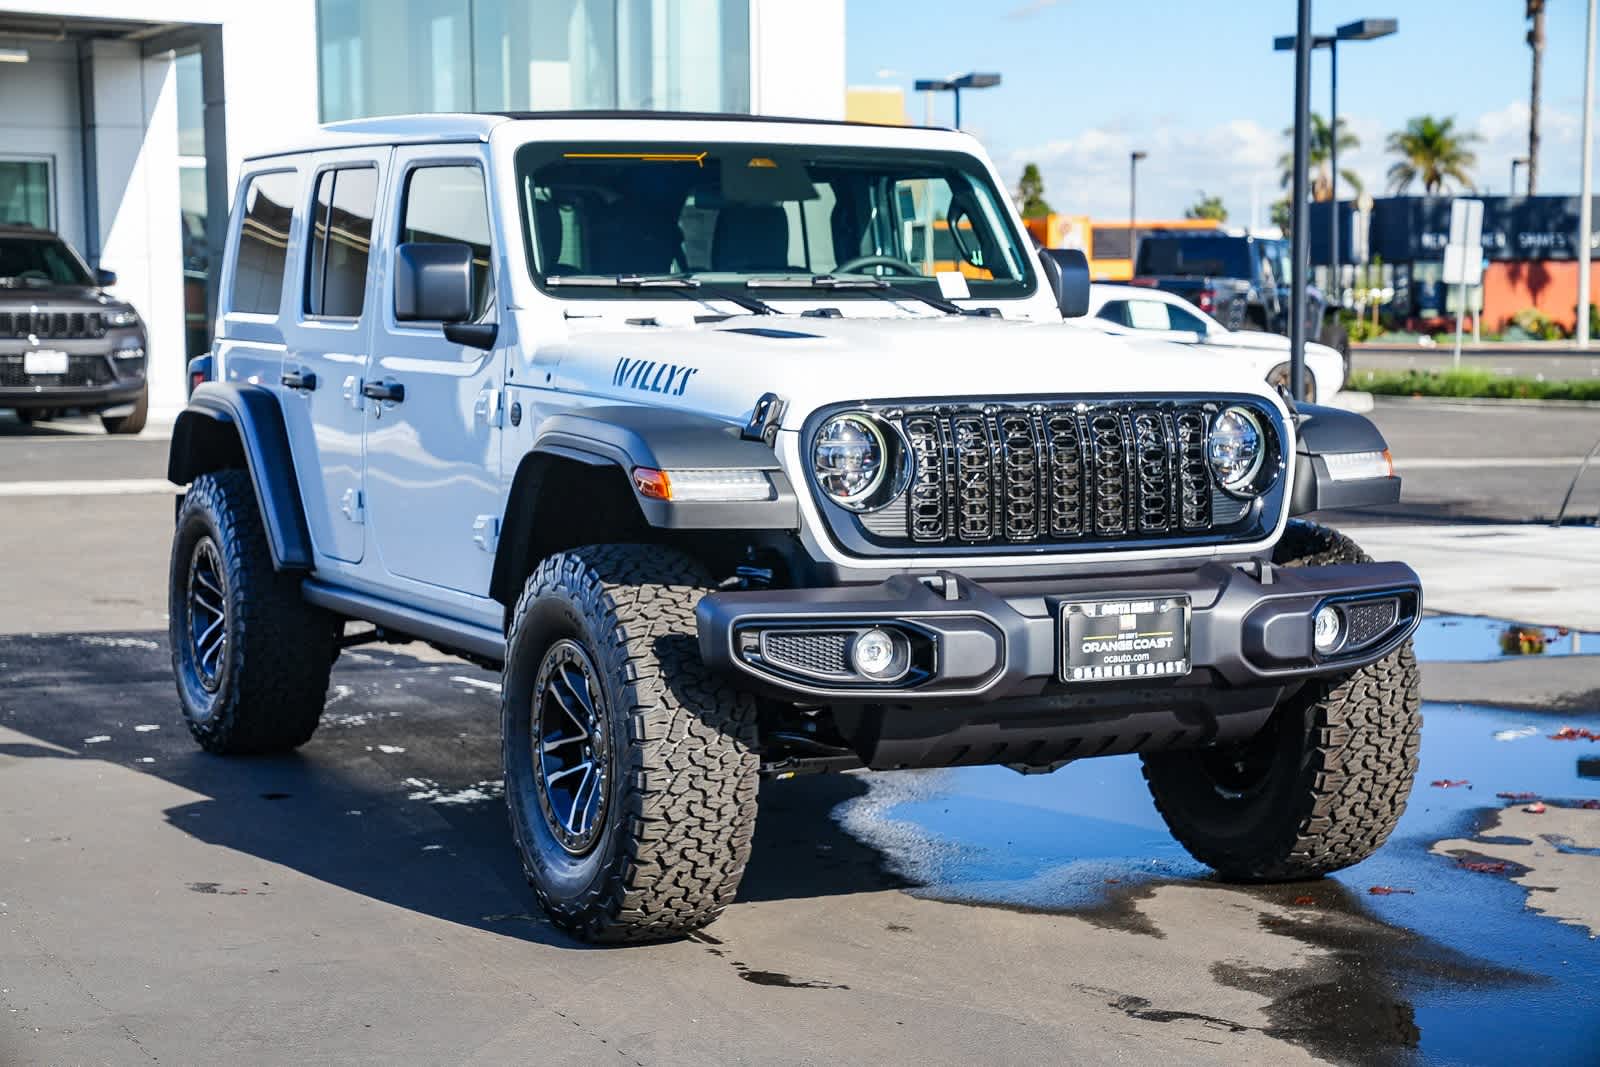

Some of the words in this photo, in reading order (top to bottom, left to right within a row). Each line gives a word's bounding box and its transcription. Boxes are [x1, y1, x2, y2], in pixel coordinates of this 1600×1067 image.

[612, 357, 699, 396] WILLYS
[1082, 640, 1133, 653] ORANGE
[1133, 637, 1173, 650] COAST
[1103, 653, 1150, 664] ocauto.com
